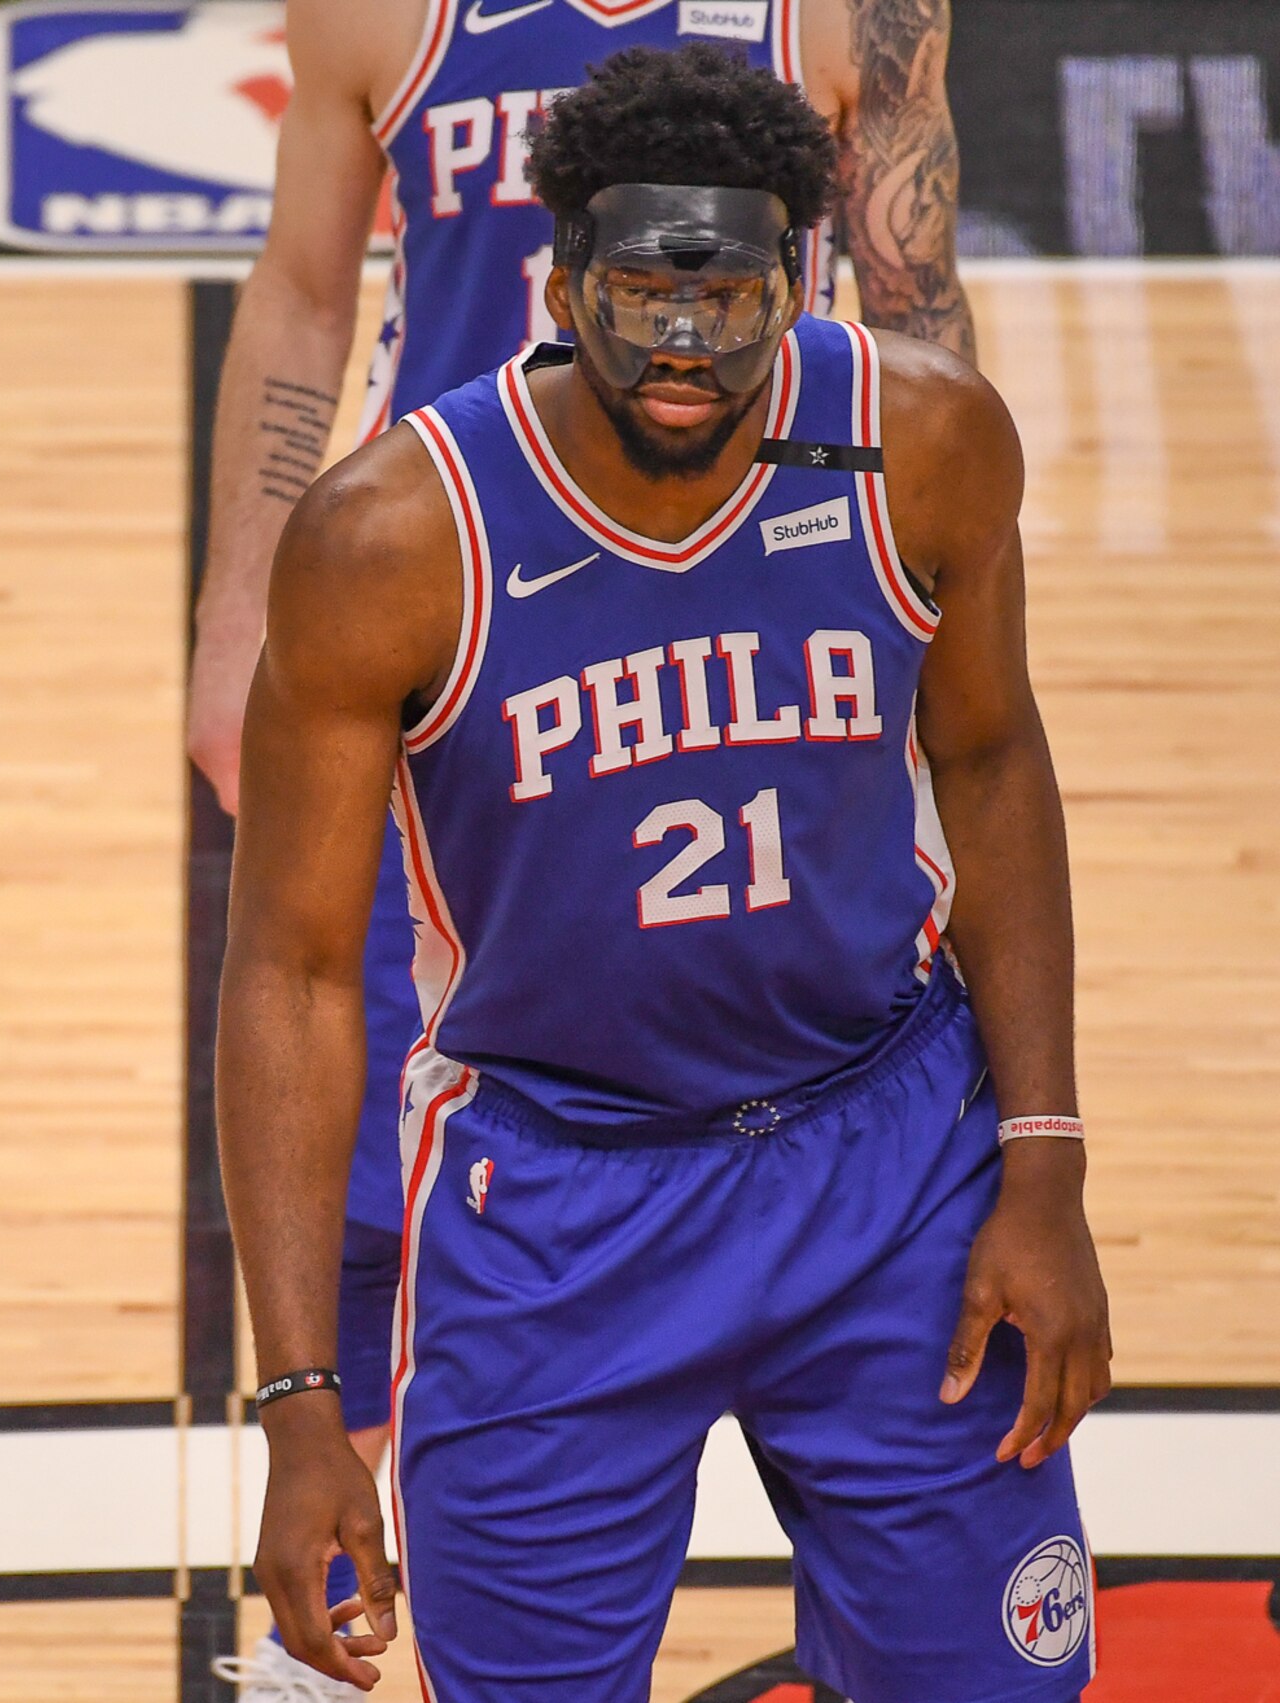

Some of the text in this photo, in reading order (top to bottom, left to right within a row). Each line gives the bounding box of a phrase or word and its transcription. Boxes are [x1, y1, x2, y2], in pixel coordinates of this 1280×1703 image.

[41, 192, 275, 234] NBA
[773, 514, 839, 542] StubHub
[502, 629, 883, 803] PHILA
[632, 787, 791, 929] 21
[1011, 1118, 1084, 1134] nstoppable
